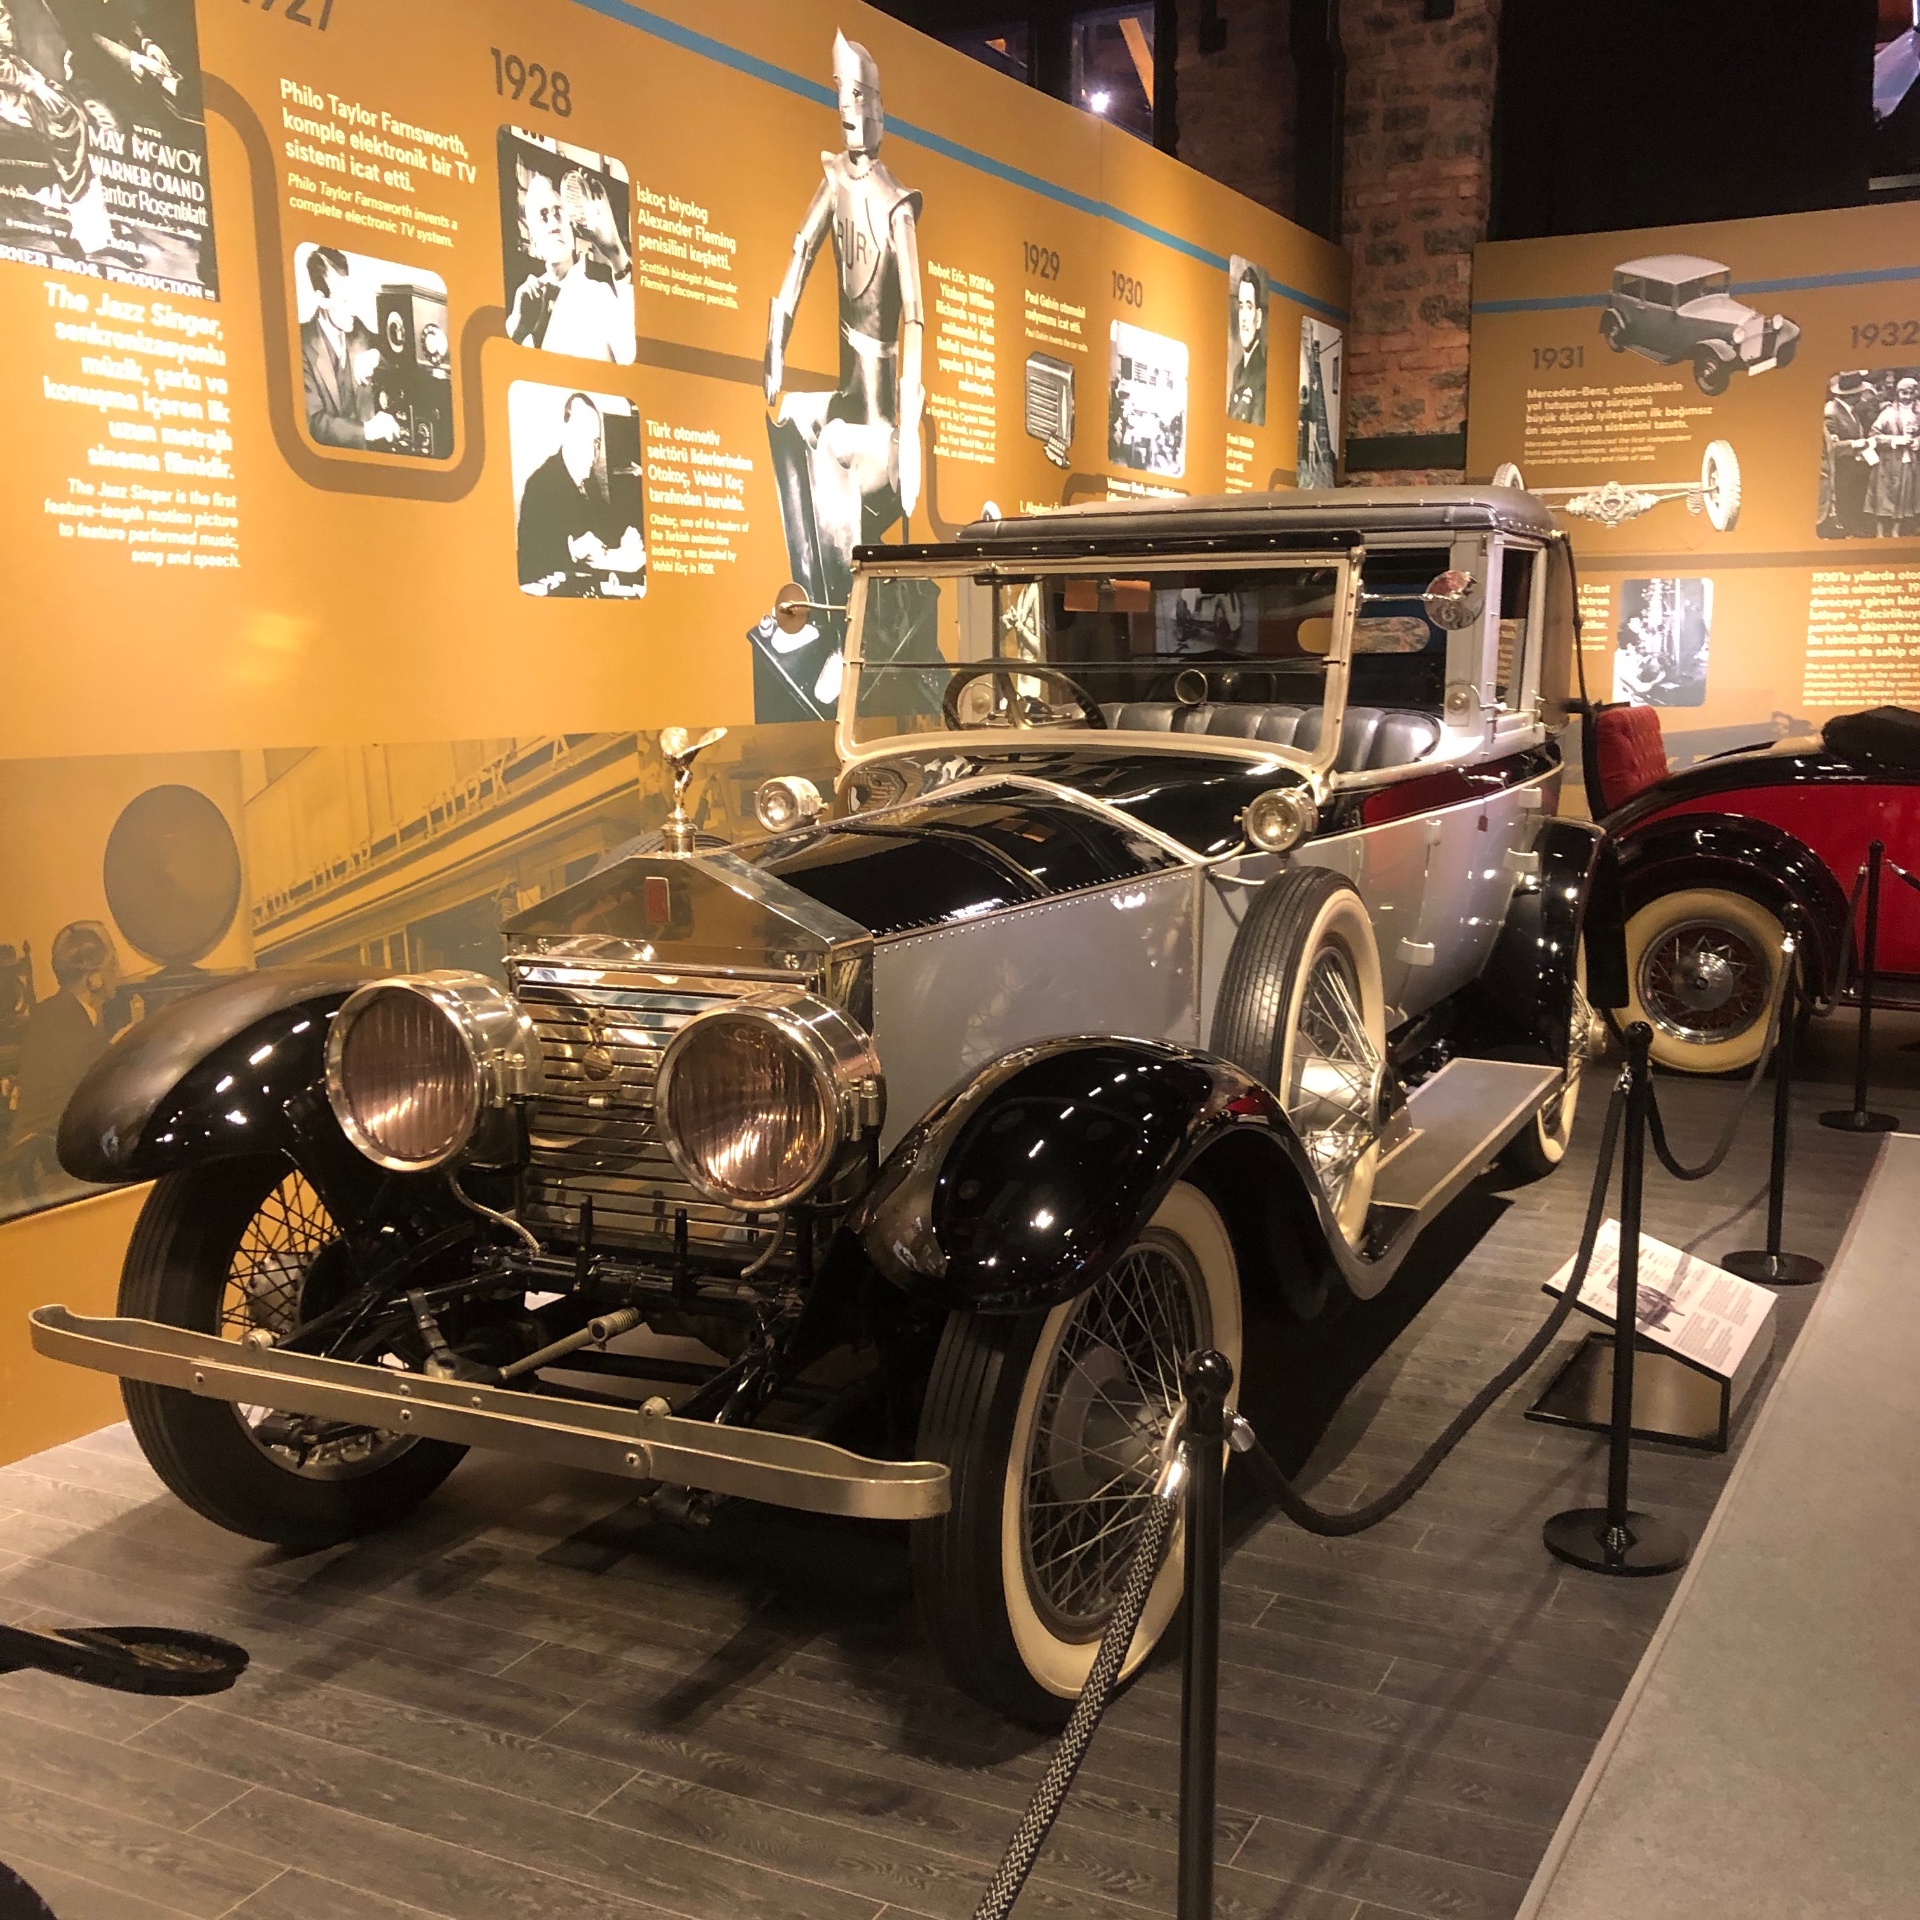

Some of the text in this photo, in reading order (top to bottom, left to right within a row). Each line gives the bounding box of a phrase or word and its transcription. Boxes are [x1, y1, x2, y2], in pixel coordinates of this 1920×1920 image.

[490, 47, 573, 118] 1928
[280, 77, 469, 160] Philo Taylor Farnsworth,
[88, 125, 125, 155] MAY
[282, 107, 477, 185] komple elektronik bir TV
[88, 153, 152, 188] WARNER
[285, 139, 415, 193] sistemi icat etti.
[101, 185, 138, 209] antor
[288, 173, 458, 231] Philo Taylor Farnsworth invents a
[636, 180, 708, 225] İskoç biyolog
[289, 195, 454, 248] complete electronic TV system.
[638, 208, 737, 255] Alexander Fleming
[1023, 241, 1060, 281] 1929
[105, 266, 204, 299] PRODUCTION
[1025, 289, 1039, 305] Paul
[1111, 270, 1143, 308] 1930
[44, 281, 223, 341] The Jazz Singer,
[1850, 320, 1920, 349] 1932
[82, 355, 150, 386] müzik,
[206, 376, 228, 394] ve
[1533, 345, 1585, 370] 1931
[43, 375, 230, 423] konuşma içeren ilk
[1591, 400, 1604, 408] ve
[109, 420, 156, 442] uzun
[646, 419, 721, 447] Türk otomotiv
[88, 444, 235, 479] sinema filmidir.
[647, 443, 688, 463] sektörü
[68, 478, 237, 508] The Jazz Singer is the first
[647, 463, 745, 496] Otokoç, Vehbi Koç
[44, 498, 238, 528] feature-length motion picture
[59, 522, 239, 550] to feature performed music,
[131, 550, 241, 569] song and speech.
